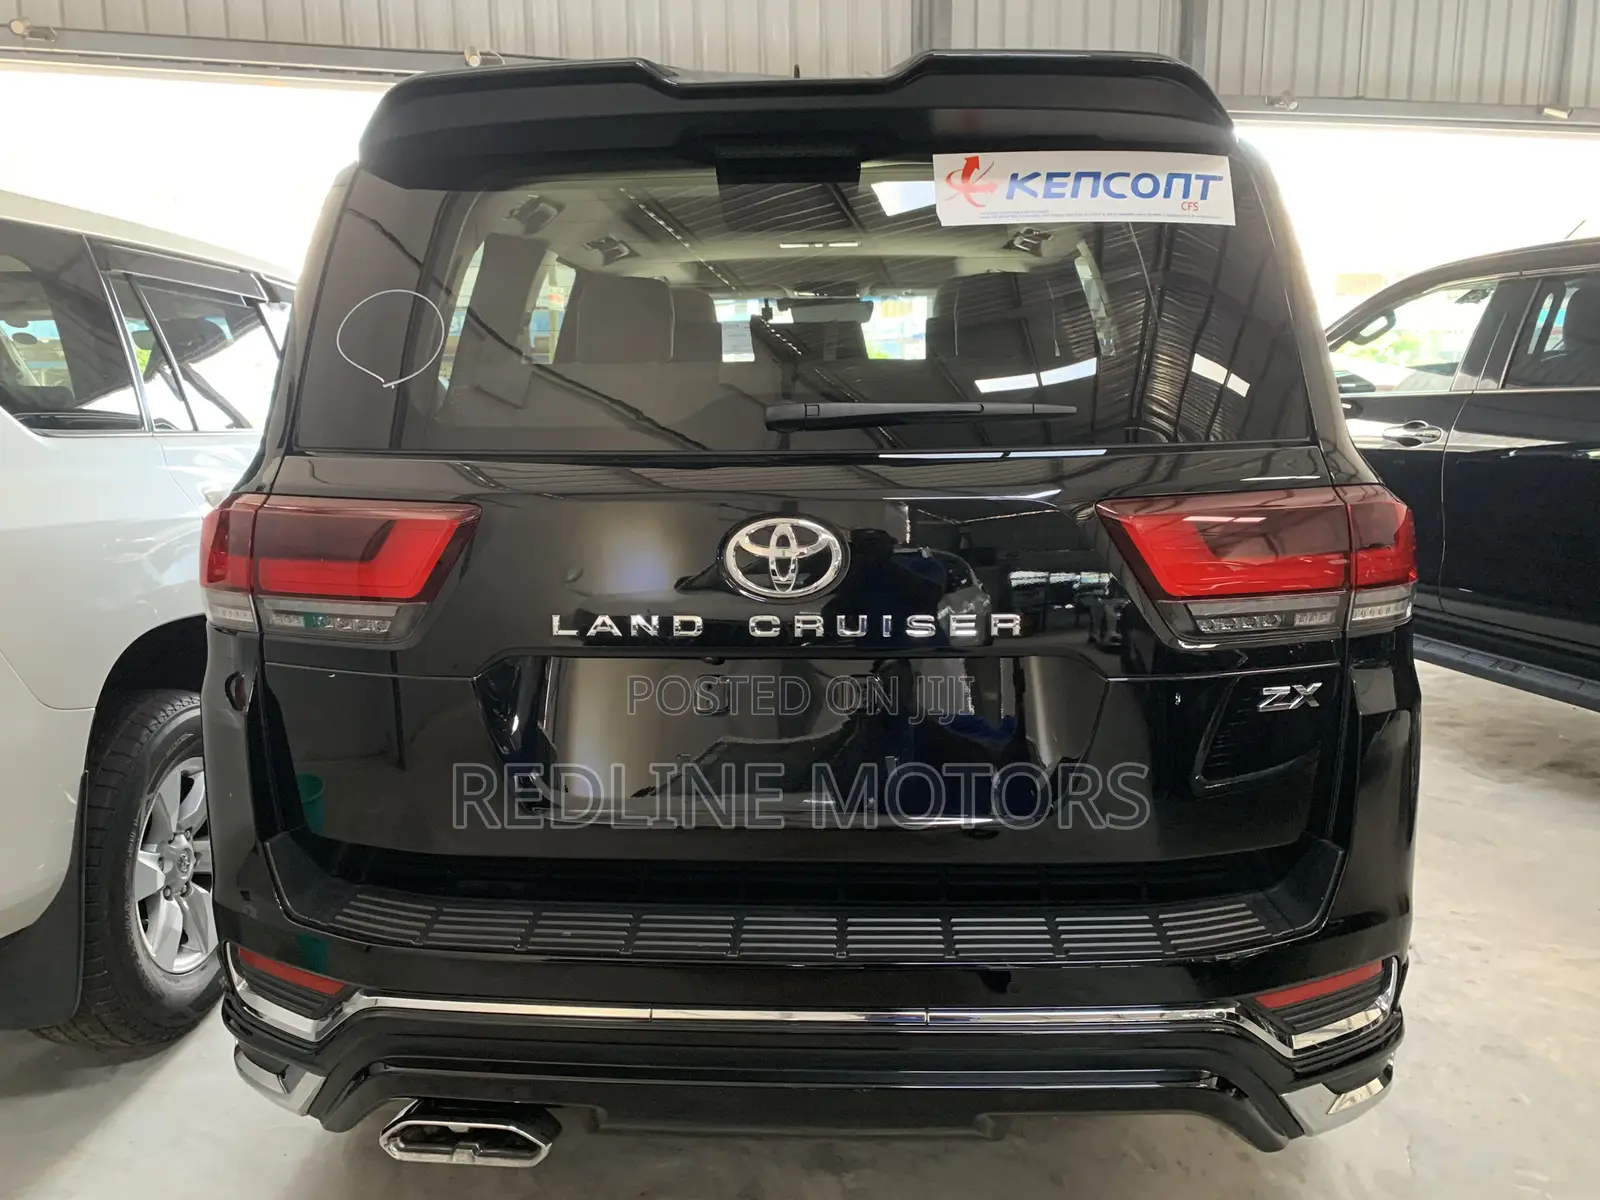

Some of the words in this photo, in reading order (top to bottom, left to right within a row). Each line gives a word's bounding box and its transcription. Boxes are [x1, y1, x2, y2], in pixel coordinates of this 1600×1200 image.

[1180, 201, 1199, 212] CFS
[552, 614, 704, 637] LAND
[748, 613, 1023, 638] CRUISER
[1257, 682, 1323, 712] ZX
